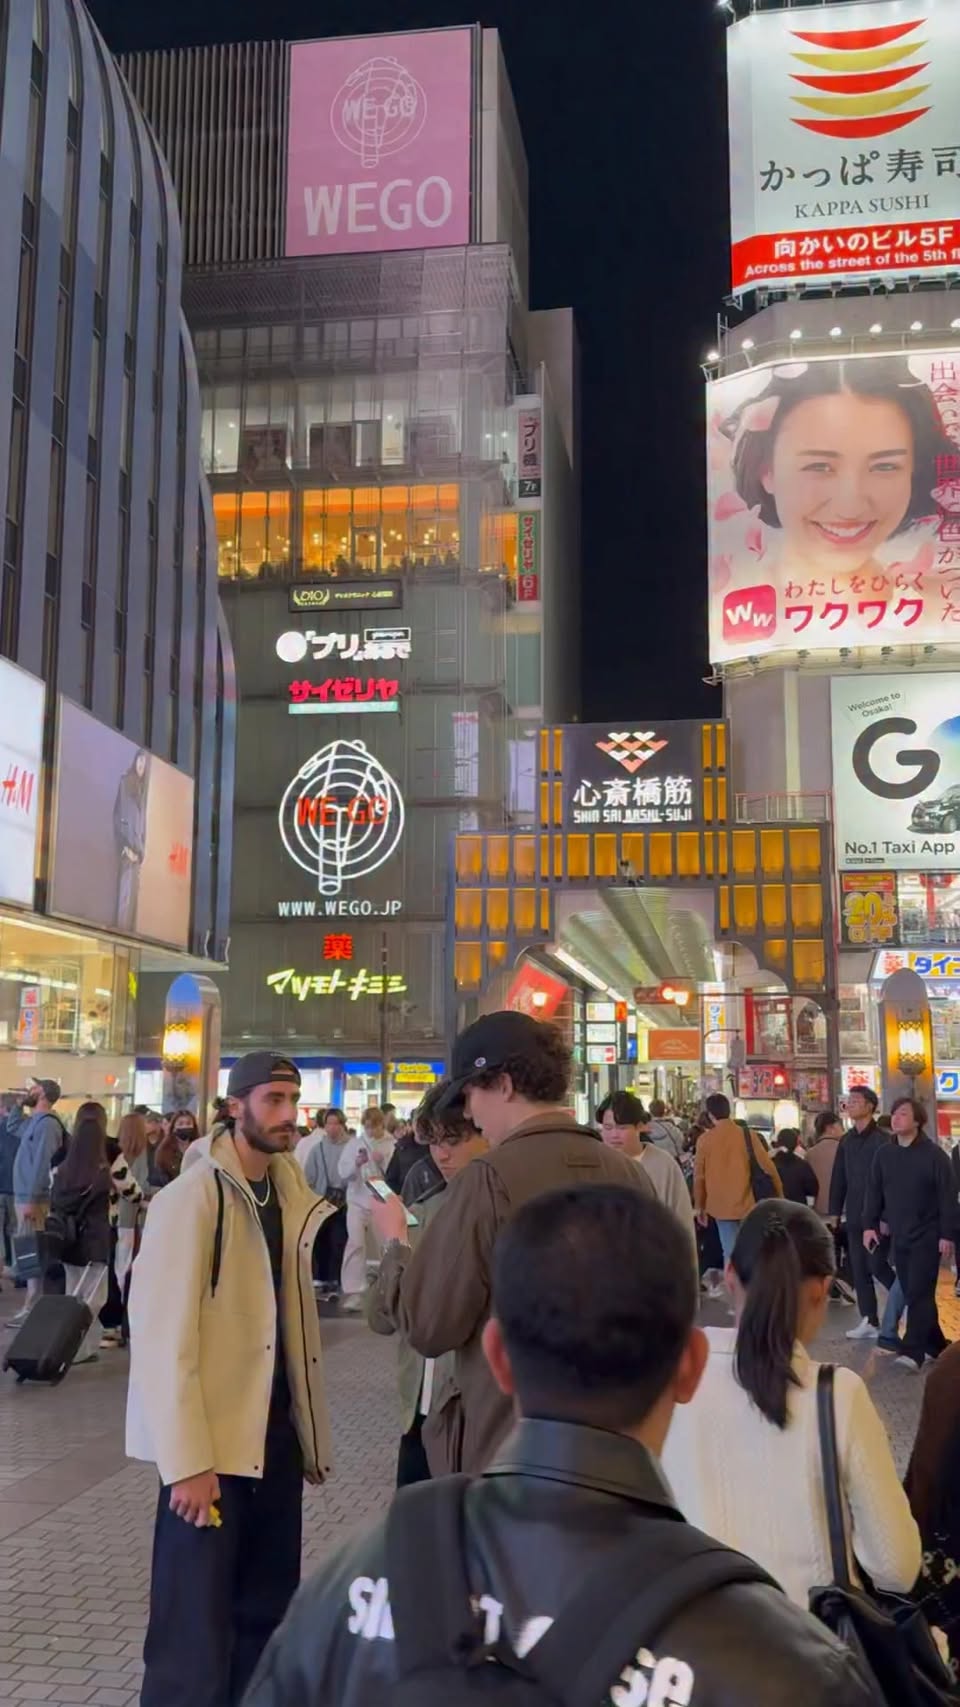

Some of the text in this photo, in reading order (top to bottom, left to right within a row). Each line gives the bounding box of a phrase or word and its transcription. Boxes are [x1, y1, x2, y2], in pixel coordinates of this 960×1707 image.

[760, 146, 960, 192] かっぱ寿司
[304, 175, 452, 237] WEGO
[795, 194, 929, 219] KAPPA SUSHI
[774, 226, 954, 259] 向かいのビル5F
[744, 262, 796, 279] Across
[800, 257, 823, 271] the
[828, 255, 871, 269] street
[875, 252, 891, 265] of
[895, 250, 918, 264] the
[923, 247, 947, 262] 5th
[784, 572, 925, 599] わたしをひらく
[785, 598, 923, 633] ワクワク
[288, 676, 399, 702] サイゼリヤ
[848, 691, 901, 713] Welcome to
[861, 703, 893, 718] Osaka!
[572, 776, 693, 807] 心斎橋筋
[845, 840, 955, 856] No.1 Taxi App
[278, 900, 402, 917] WWW.WEGO.JP
[323, 934, 353, 960] 薬
[266, 968, 407, 1001] マツモトキヨシ
